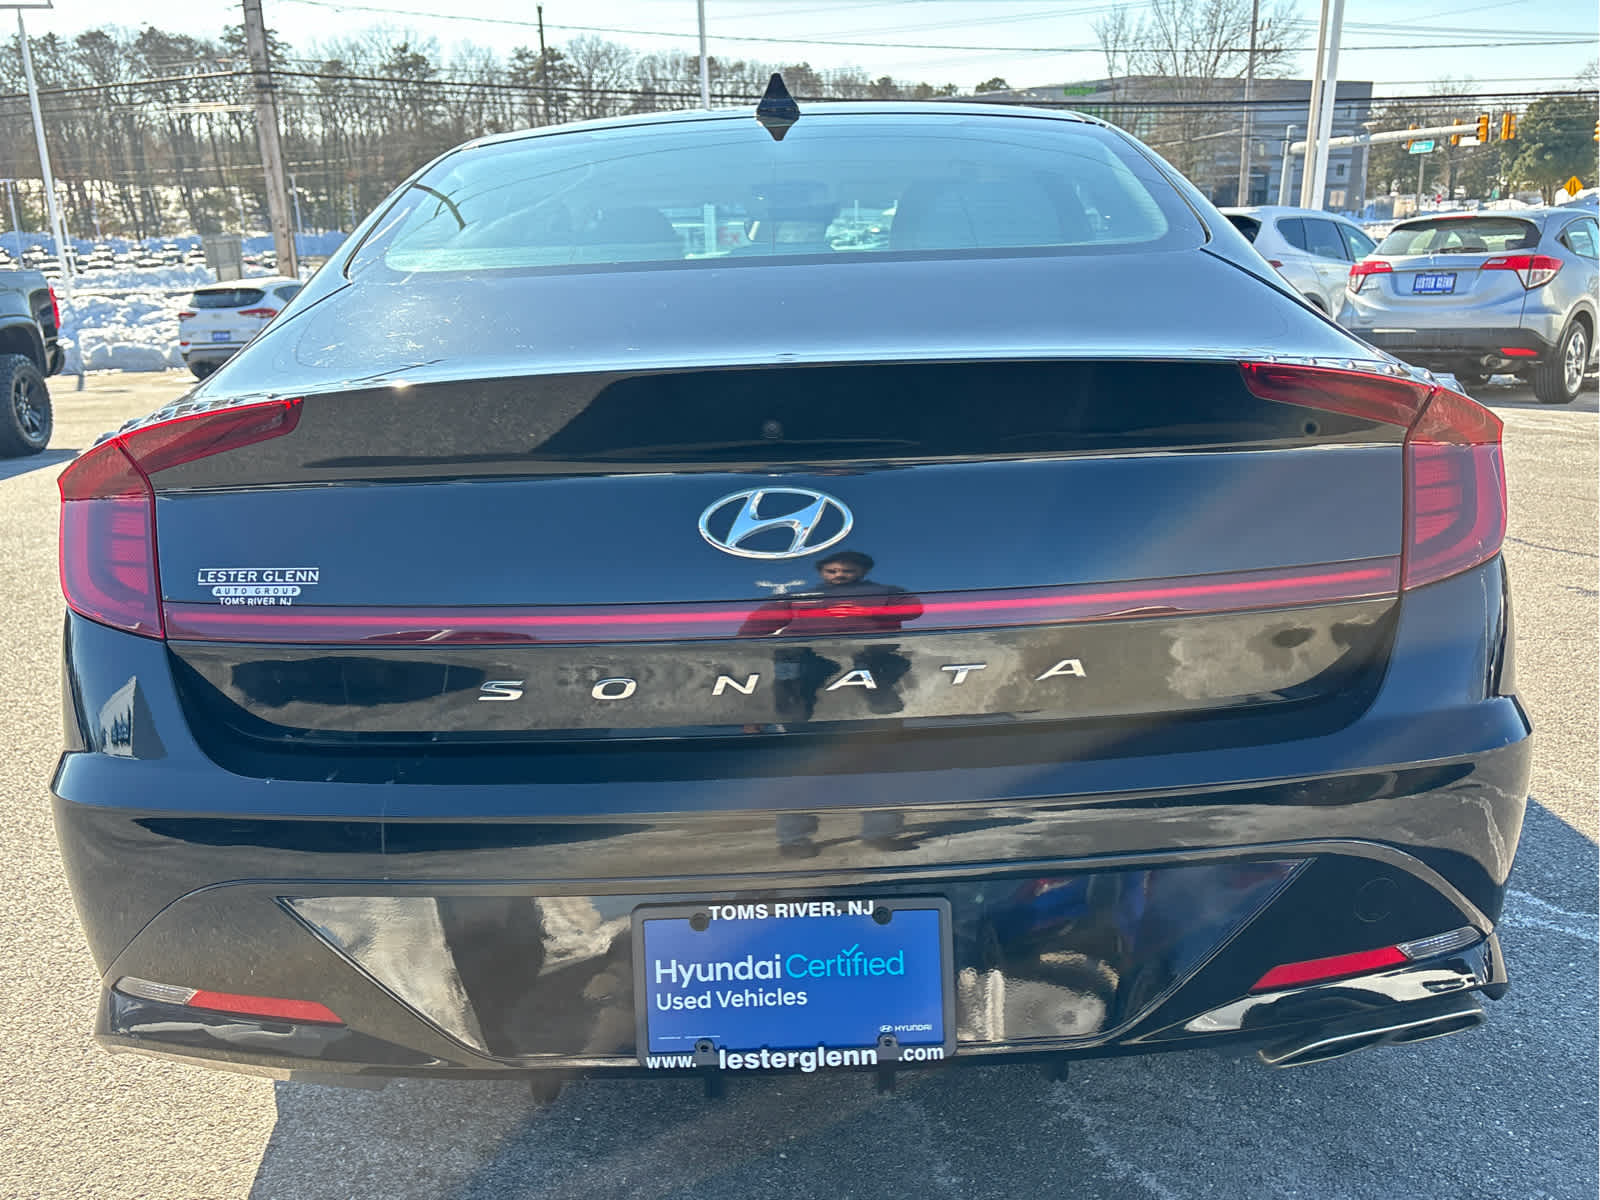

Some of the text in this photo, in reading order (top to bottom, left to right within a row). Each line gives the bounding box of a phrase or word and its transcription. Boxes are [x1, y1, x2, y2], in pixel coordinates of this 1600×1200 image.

[198, 570, 320, 582] LESTER GLENN
[215, 587, 298, 595] AUTO GROUP
[219, 597, 292, 606] TOMS RIVER NJ
[478, 658, 1088, 702] SONATA
[708, 900, 875, 922] TOMS RIVER, NJ
[655, 943, 905, 989] Hyundai Certified
[656, 987, 808, 1011] Used Vehicles
[894, 1024, 933, 1032] HYUNDAI
[646, 1046, 945, 1073] www. lesterglenn .com
